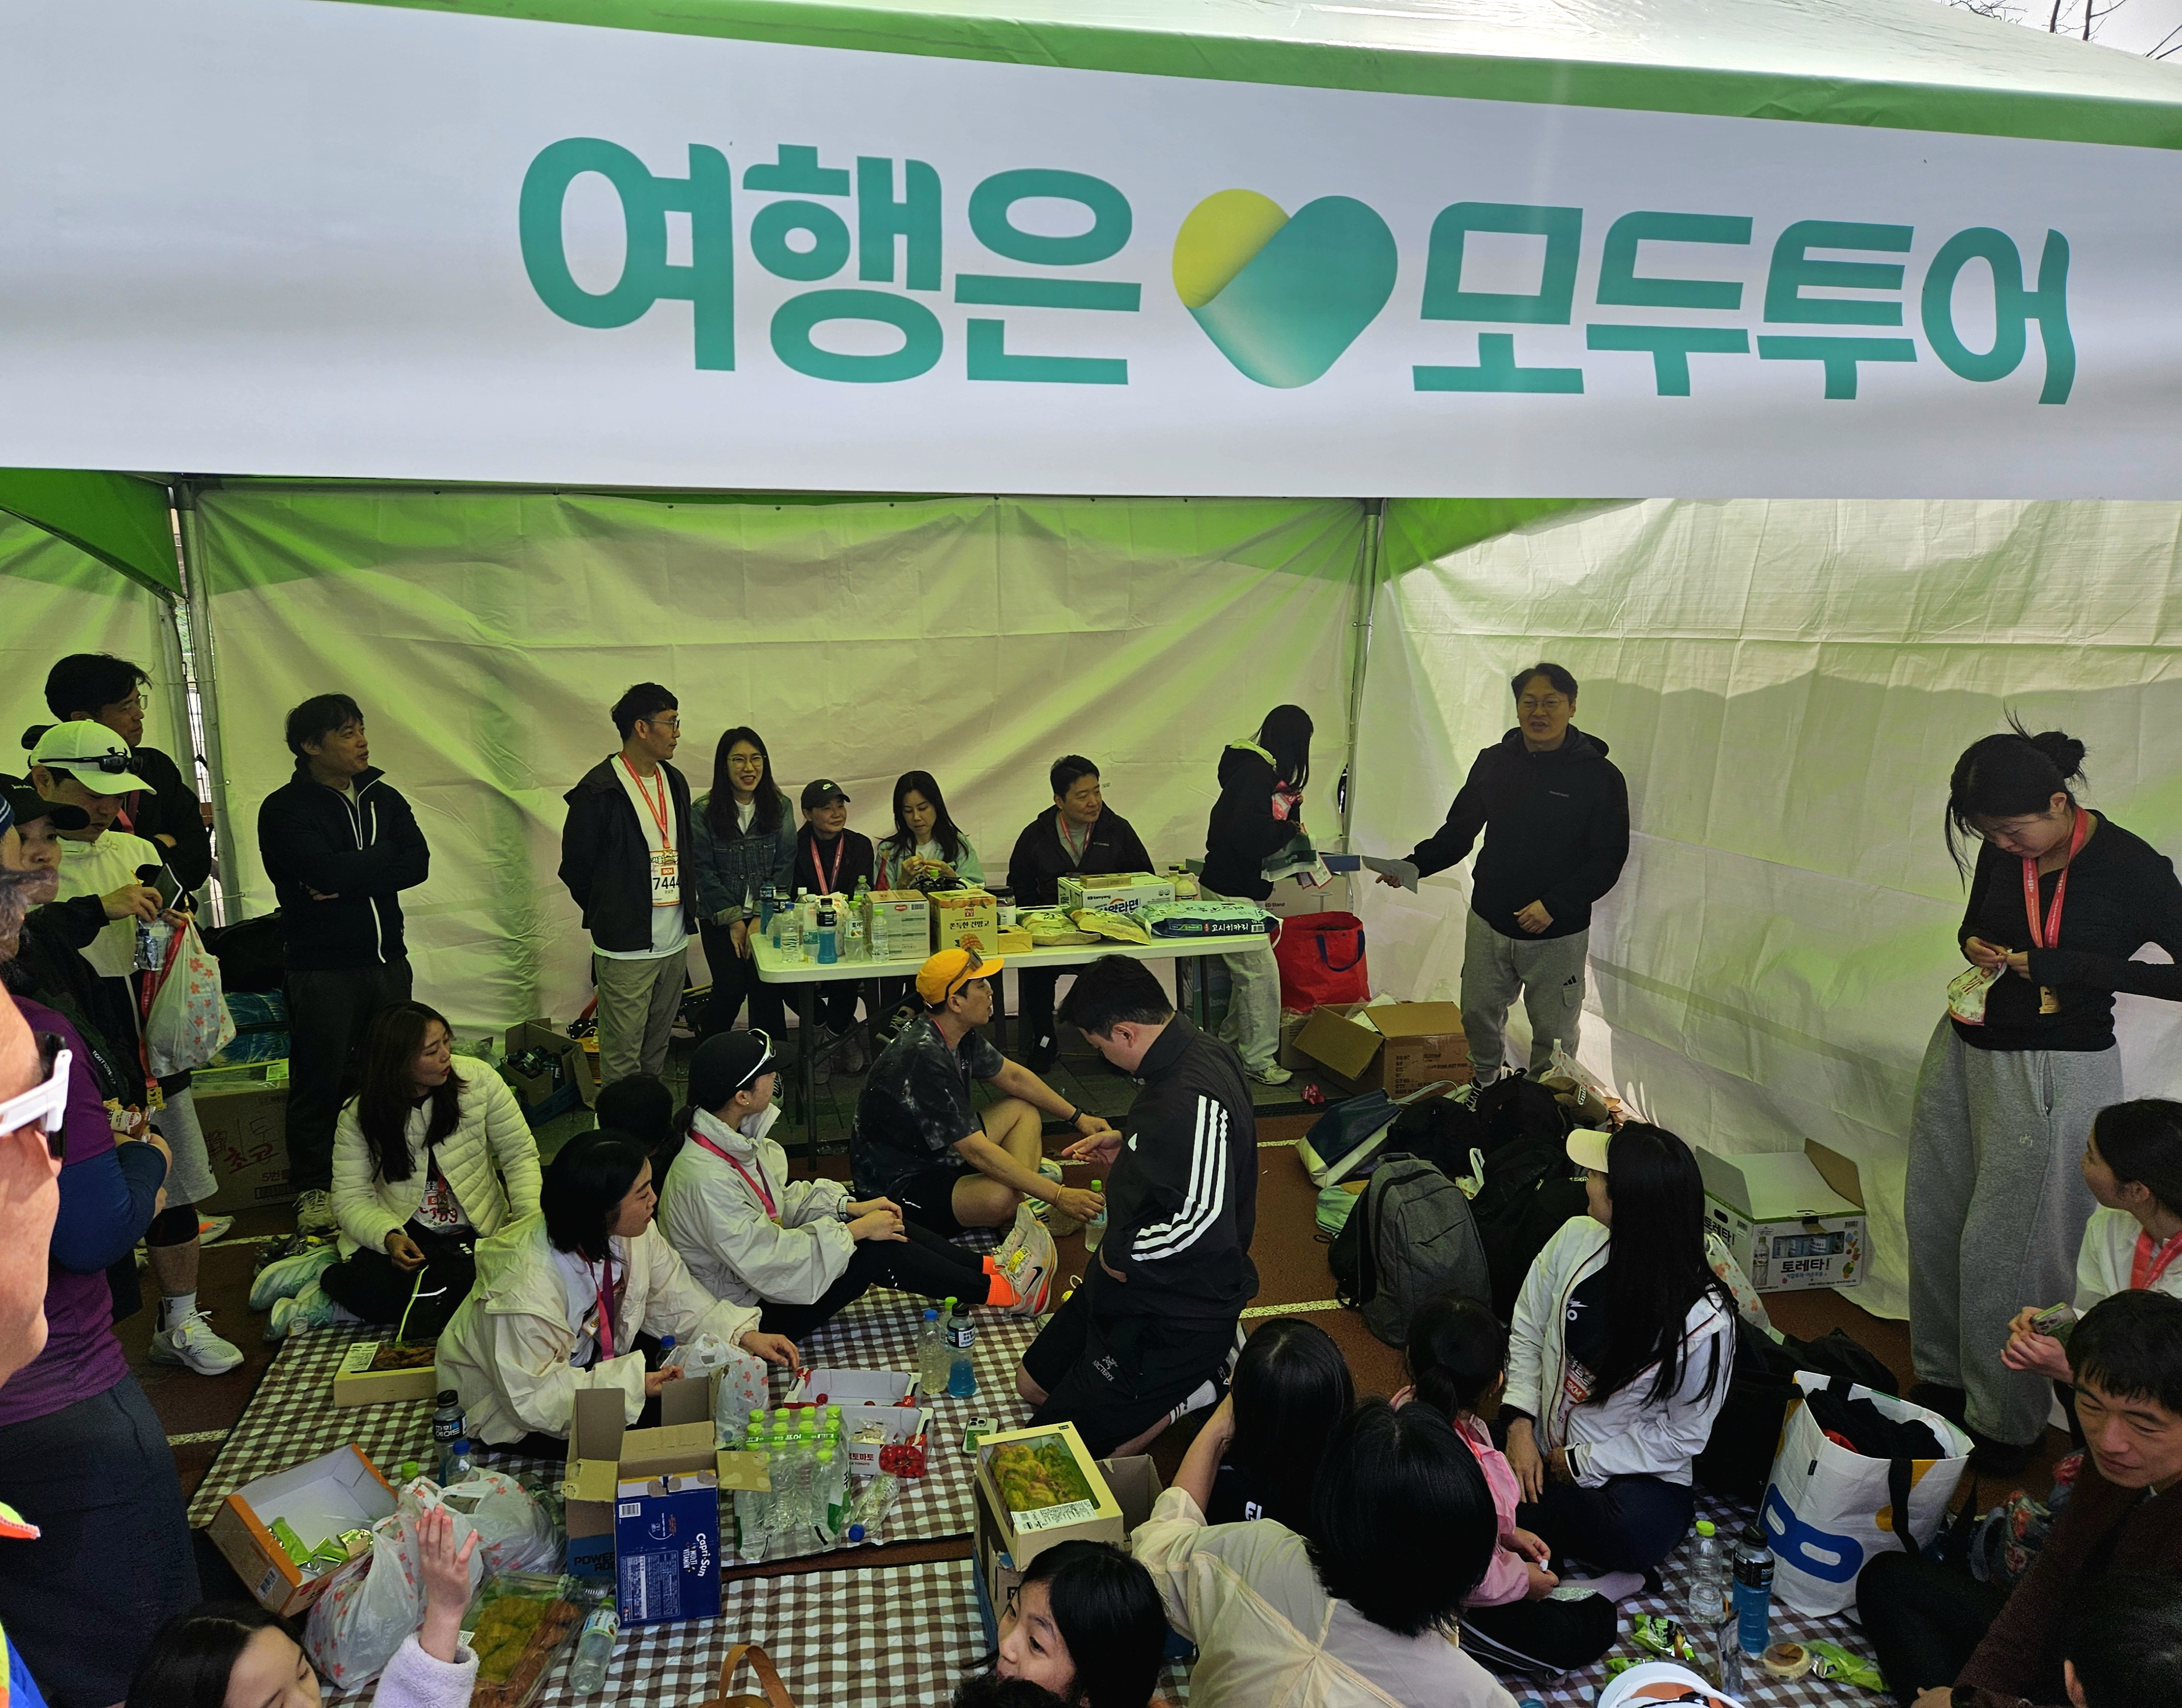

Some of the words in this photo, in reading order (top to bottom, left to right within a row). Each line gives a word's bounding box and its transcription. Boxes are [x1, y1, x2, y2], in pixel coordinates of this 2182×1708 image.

[519, 136, 1141, 385] 여행은
[1412, 201, 2076, 405] 모두투어
[1100, 898, 1139, 913] 양라면
[1211, 923, 1248, 932] 고시히카리
[1781, 1258, 1830, 1273] 토레타!
[574, 1551, 615, 1566] POWER
[689, 1549, 698, 1565] MULTI
[696, 1533, 710, 1577] Capri-Sun
